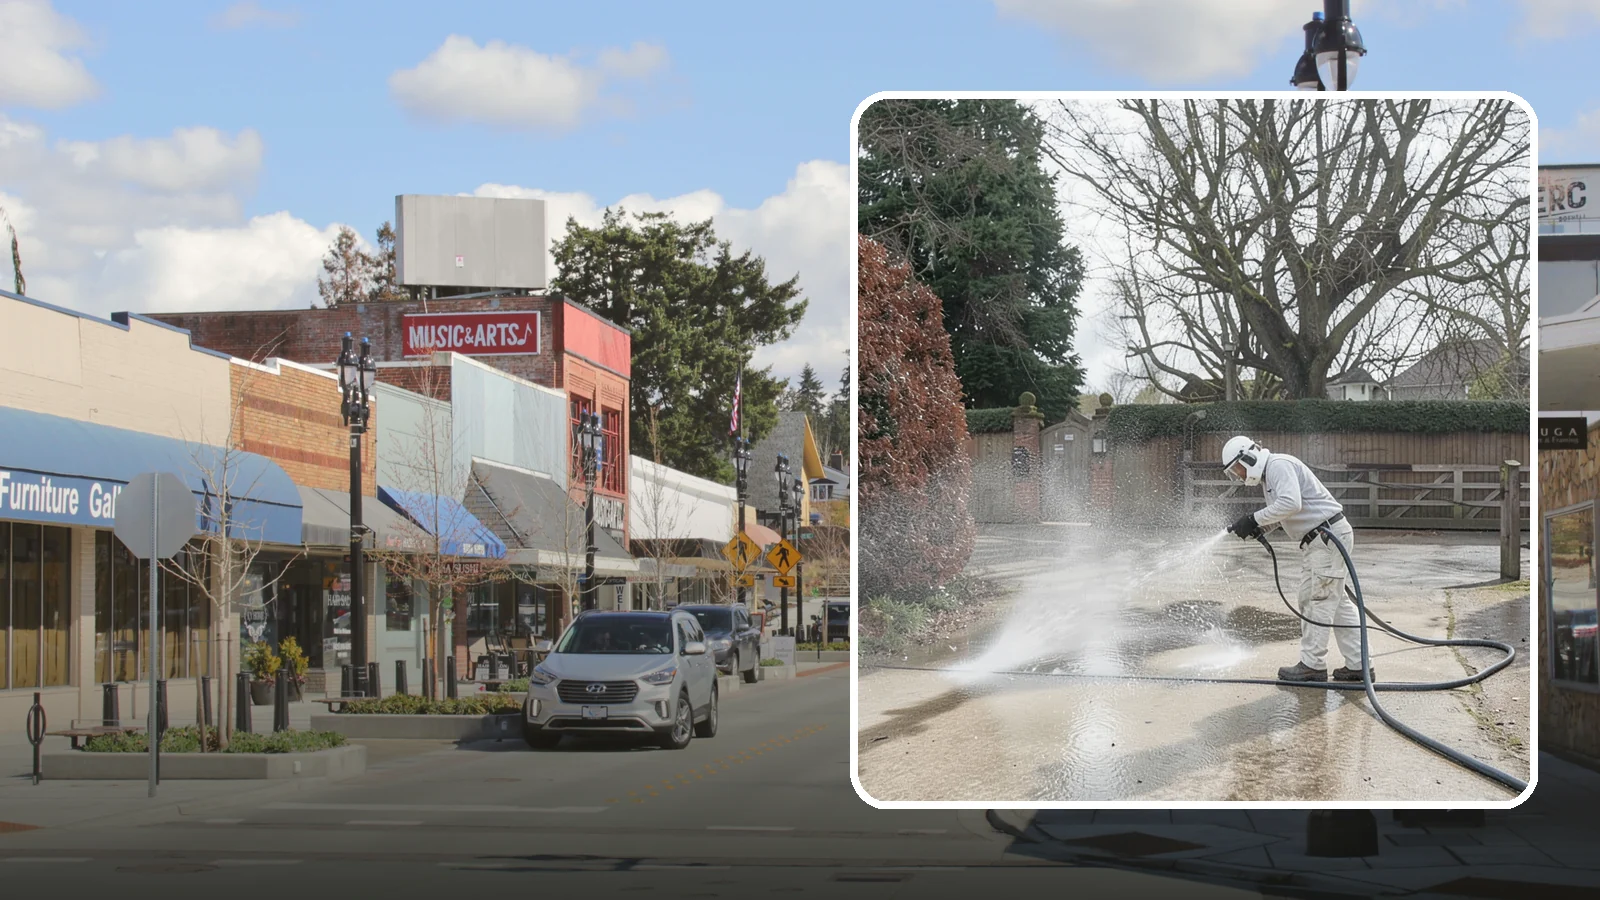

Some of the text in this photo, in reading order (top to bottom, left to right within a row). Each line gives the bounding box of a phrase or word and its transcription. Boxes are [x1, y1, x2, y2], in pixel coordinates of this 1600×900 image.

[1540, 427, 1577, 436] UGA
[0, 471, 79, 515] Furniture
[453, 563, 479, 574] SUSHI
